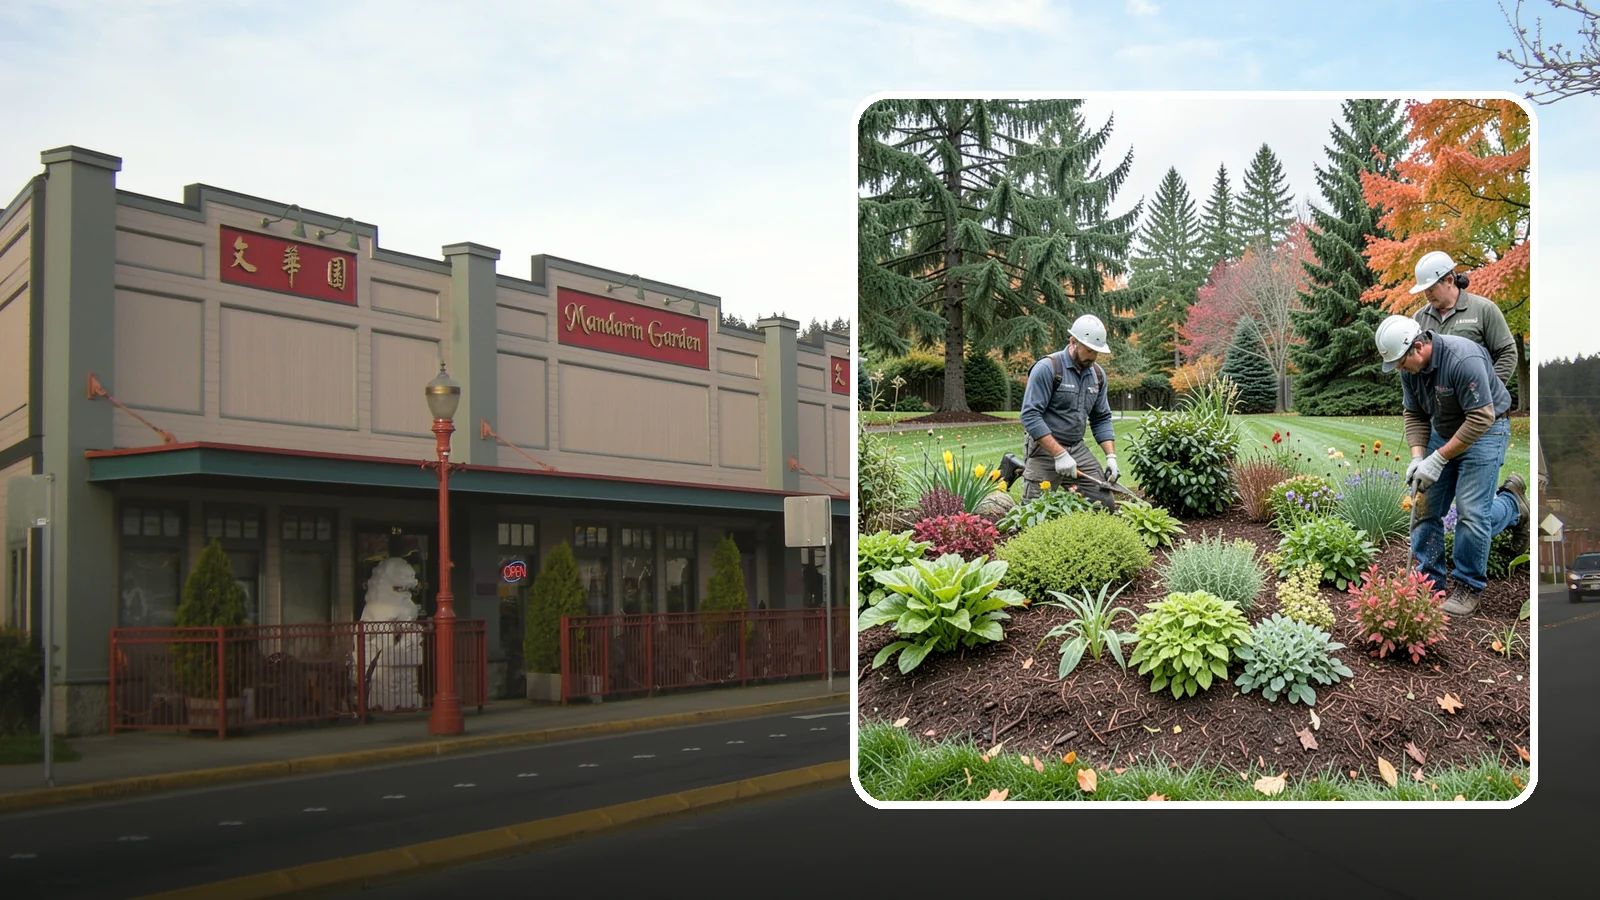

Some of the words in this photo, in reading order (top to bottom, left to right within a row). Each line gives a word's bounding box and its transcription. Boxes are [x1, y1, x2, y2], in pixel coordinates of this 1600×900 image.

[564, 302, 644, 341] Mandarin
[648, 320, 701, 352] Garden
[503, 565, 527, 578] OPEN
